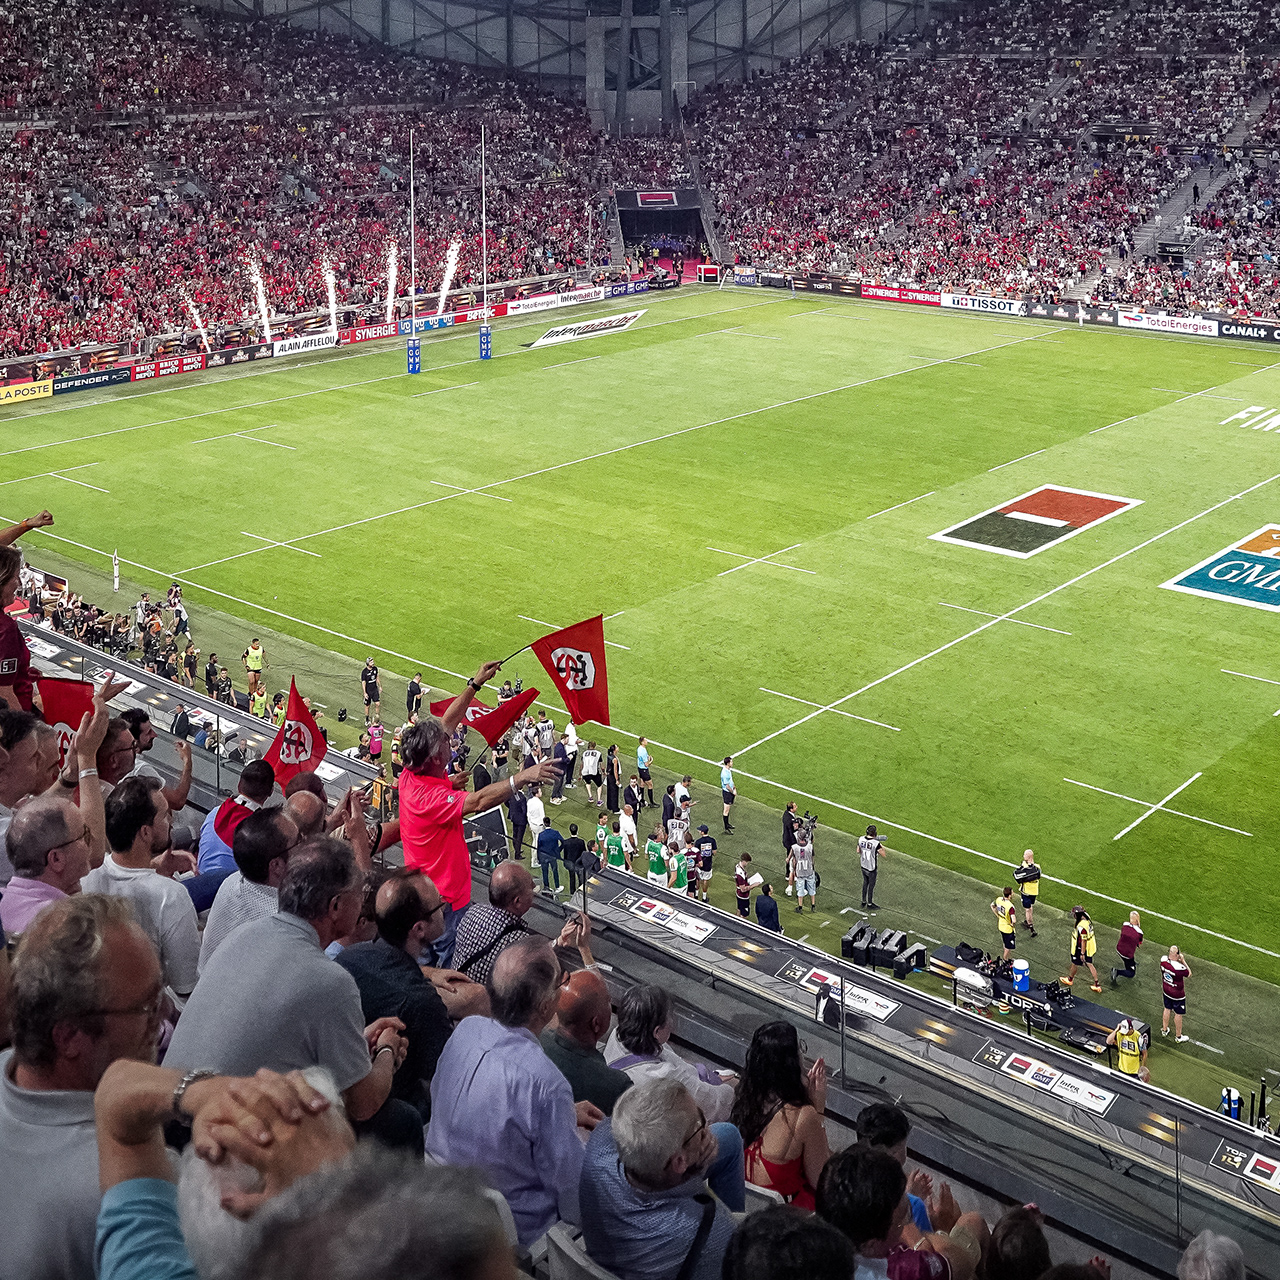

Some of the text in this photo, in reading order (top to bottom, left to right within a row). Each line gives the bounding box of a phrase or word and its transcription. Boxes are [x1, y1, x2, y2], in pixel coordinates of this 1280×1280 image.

[868, 288, 900, 298] SYNERGIE
[970, 298, 1014, 312] TISSOT
[1146, 317, 1212, 332] TotalEnergies
[1222, 324, 1267, 338] CANAL+
[356, 323, 396, 341] SYNERGIE
[278, 335, 335, 353] ALAIN AFFLELOU
[54, 374, 109, 390] DEFENDER
[13, 384, 50, 398] POSTE
[1033, 1072, 1052, 1085] GMF
[1225, 1145, 1248, 1159] TOP
